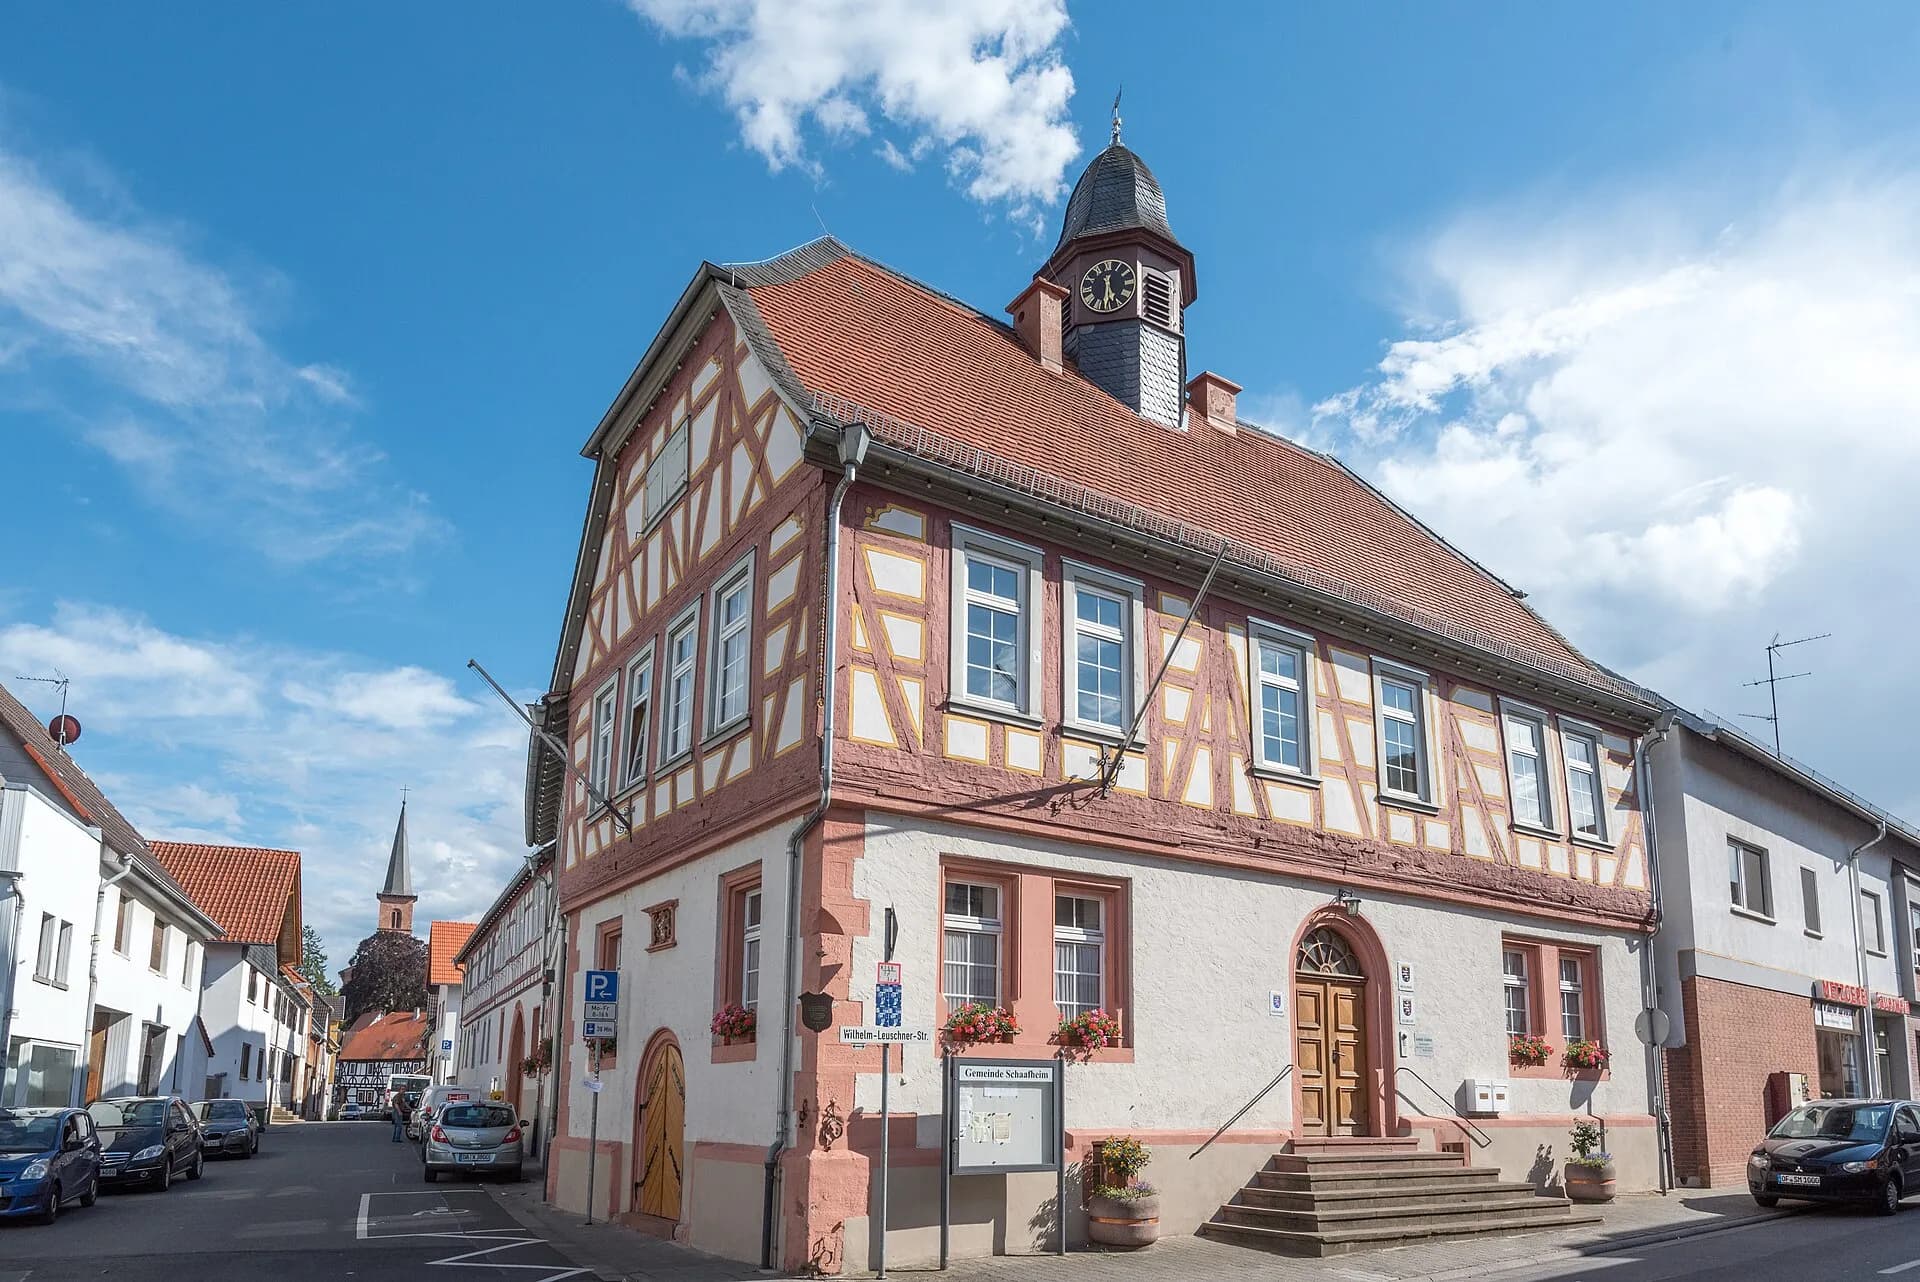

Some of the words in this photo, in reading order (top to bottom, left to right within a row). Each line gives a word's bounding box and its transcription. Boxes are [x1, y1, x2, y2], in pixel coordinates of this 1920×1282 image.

[591, 974, 608, 998] P
[843, 1029, 929, 1041] Wilhelm-Leuschner-Str.
[964, 1068, 1004, 1079] Gemeinde
[1005, 1070, 1049, 1079] Schaafheim
